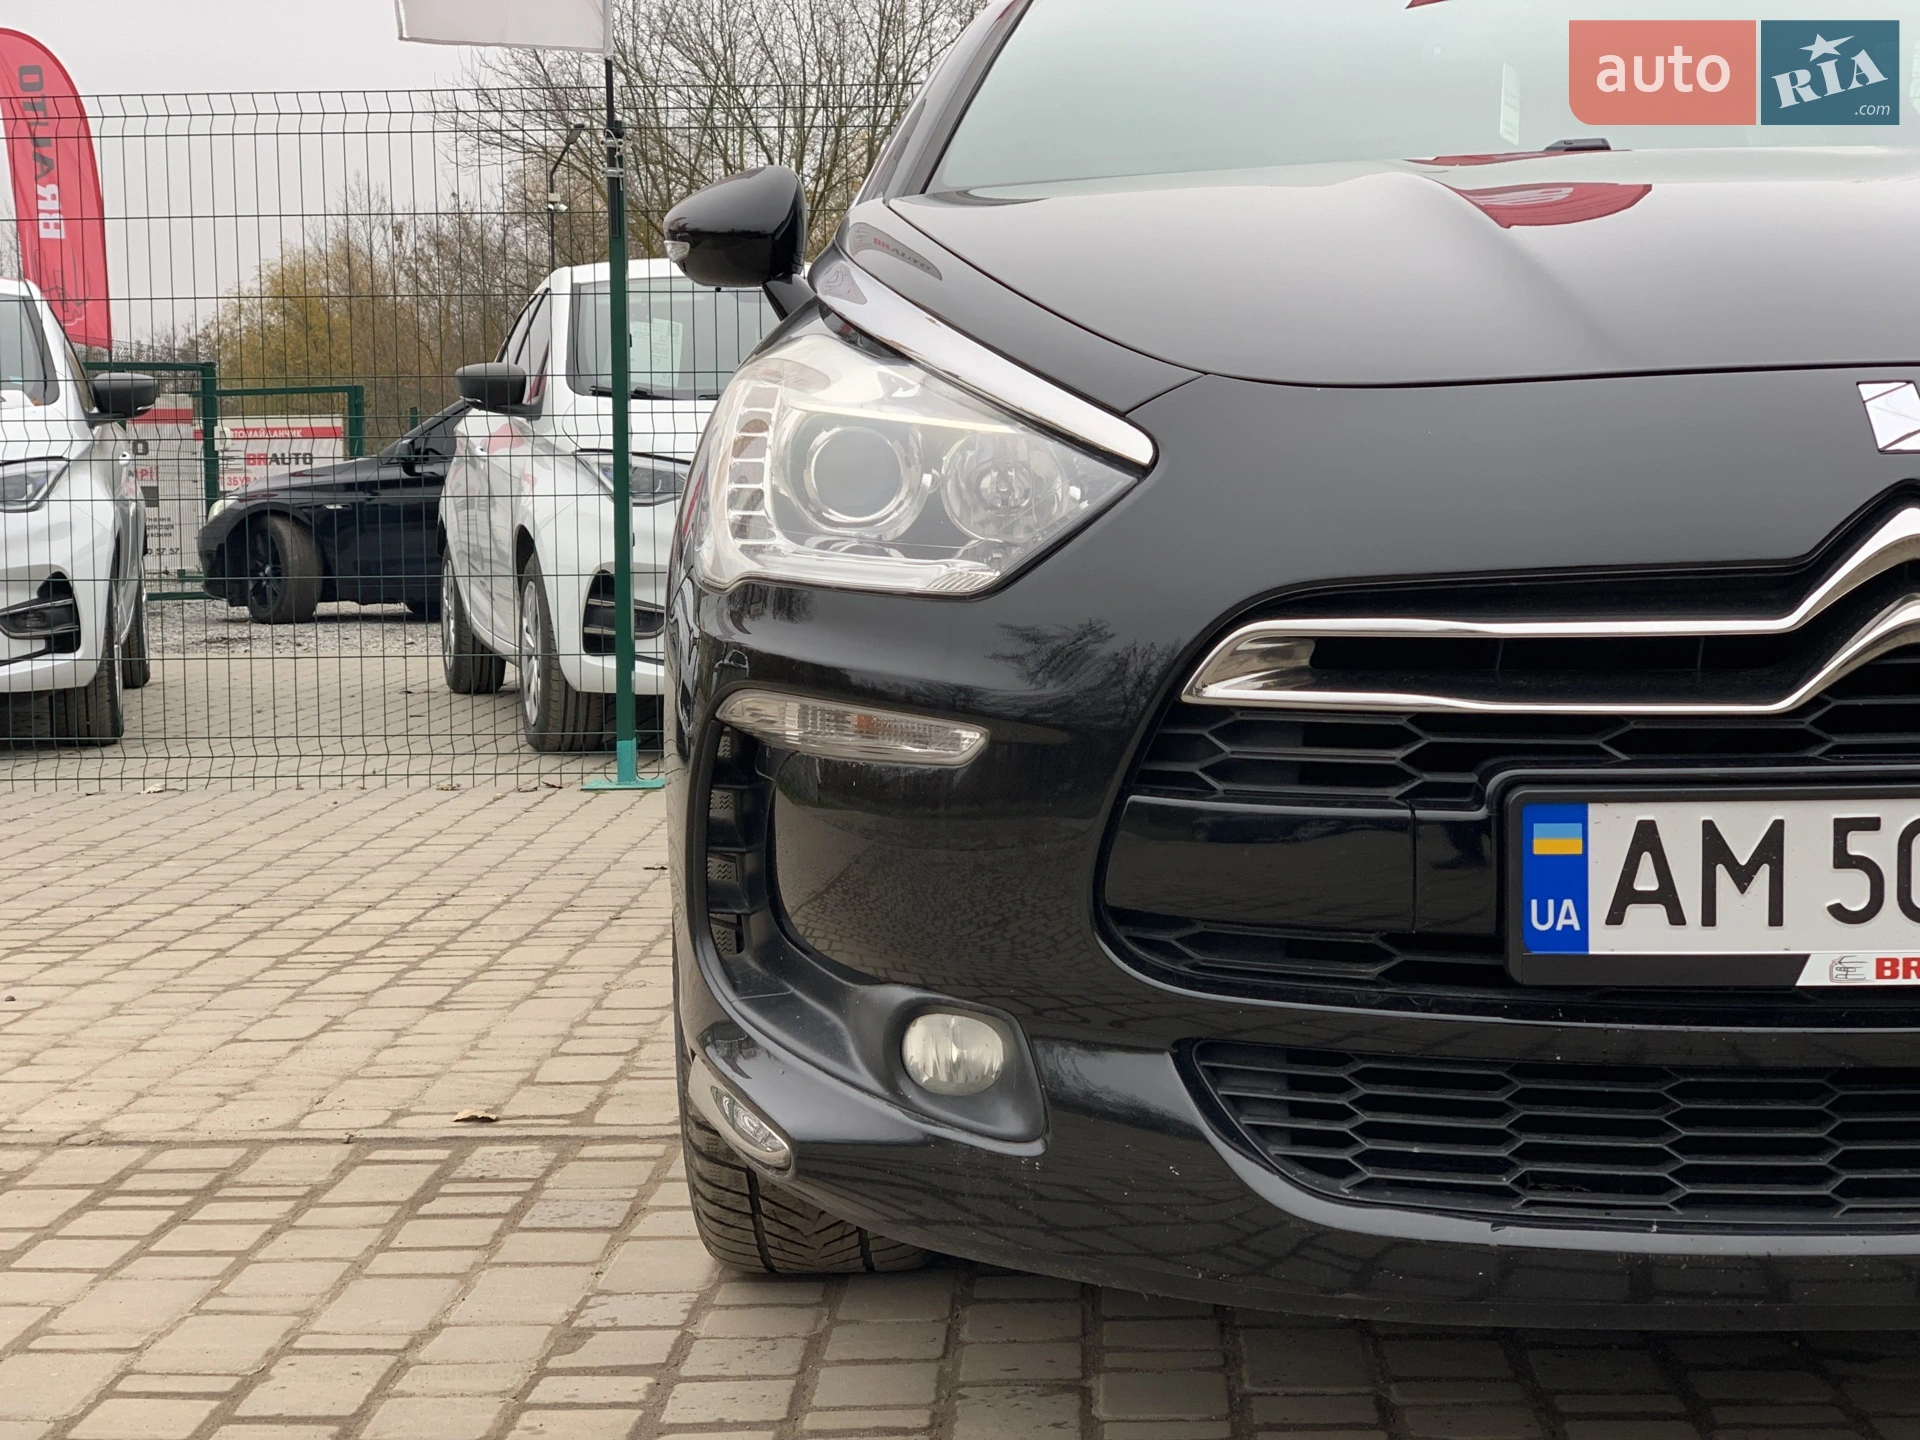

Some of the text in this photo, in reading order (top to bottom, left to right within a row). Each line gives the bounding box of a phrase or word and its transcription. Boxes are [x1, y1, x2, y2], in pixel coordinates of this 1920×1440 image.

[230, 428, 303, 439] ВТОМАЙДАНЧИК
[245, 452, 314, 467] BRAUTO
[1604, 819, 1786, 927] AM
[1530, 899, 1580, 931] UA
